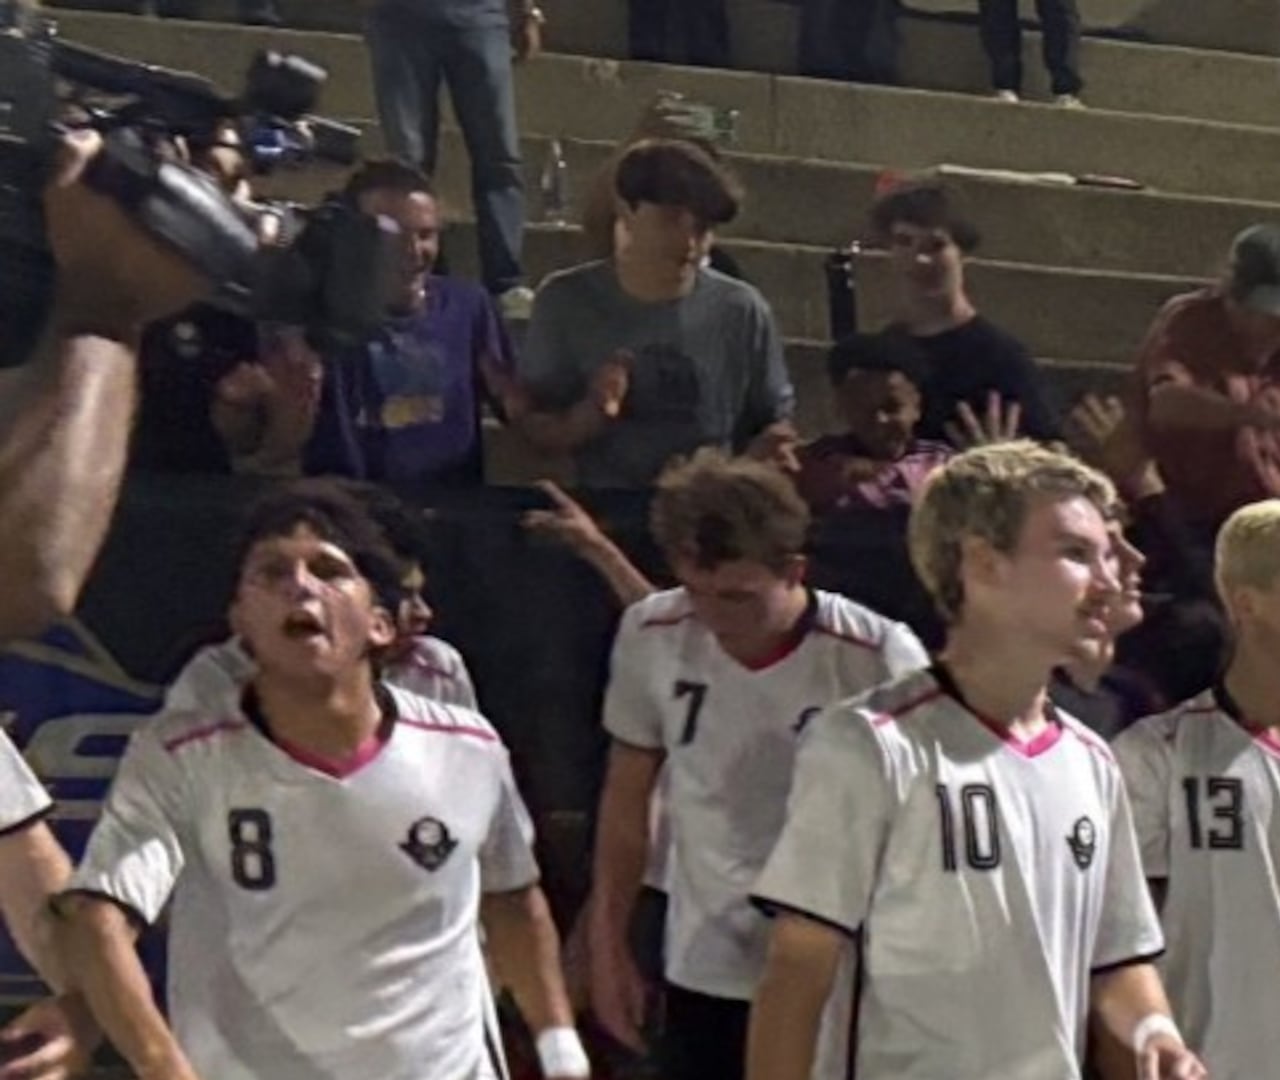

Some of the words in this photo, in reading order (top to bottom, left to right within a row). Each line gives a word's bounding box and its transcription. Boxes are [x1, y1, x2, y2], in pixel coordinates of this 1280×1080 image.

[674, 681, 708, 745] 7
[228, 807, 276, 891] 8
[936, 782, 1001, 872] 10
[1182, 777, 1244, 850] 13
